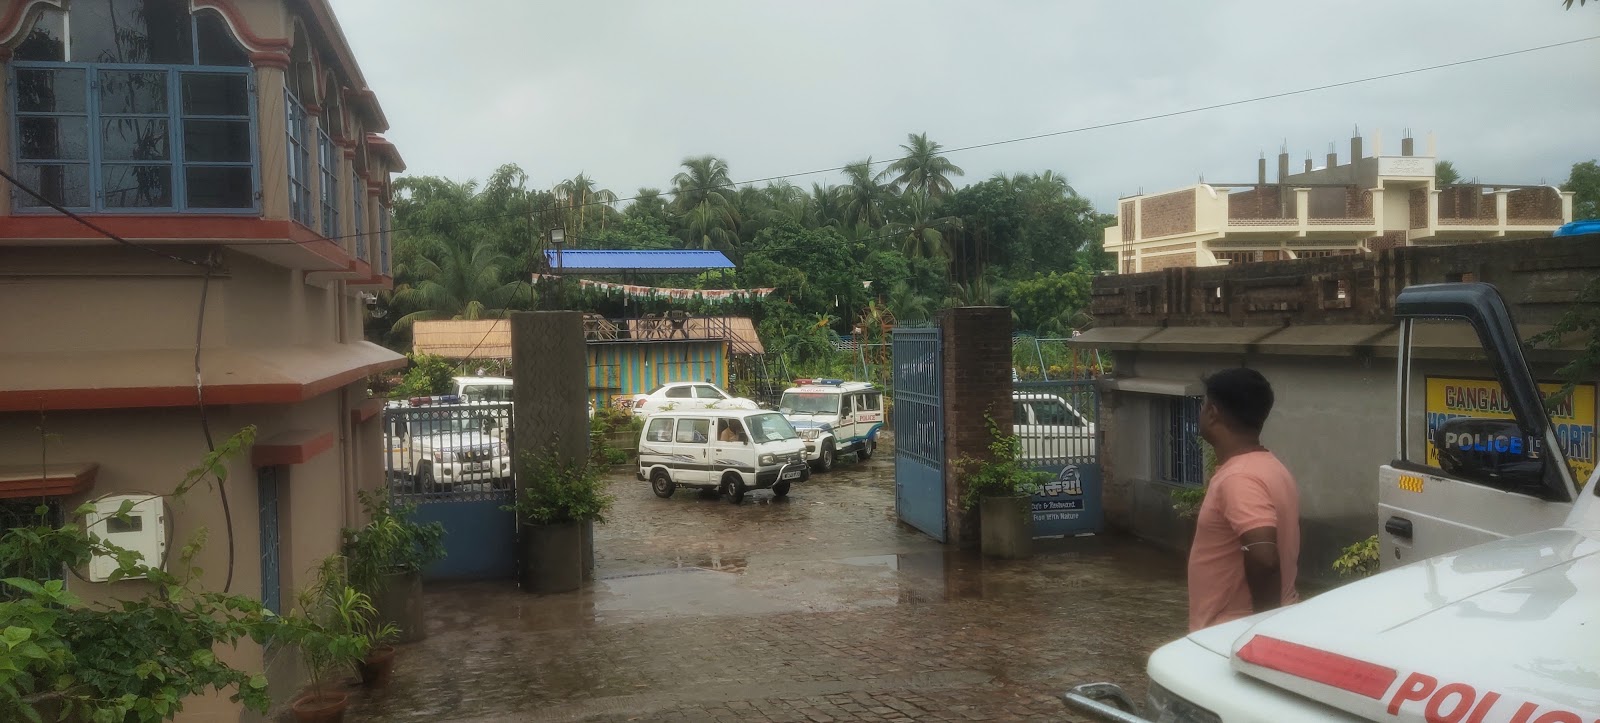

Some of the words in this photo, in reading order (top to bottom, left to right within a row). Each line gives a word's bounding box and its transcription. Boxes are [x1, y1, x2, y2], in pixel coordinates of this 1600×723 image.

[1445, 385, 1574, 418] GANGADAN
[1446, 432, 1522, 454] POLICE
[1060, 512, 1080, 520] Nature
